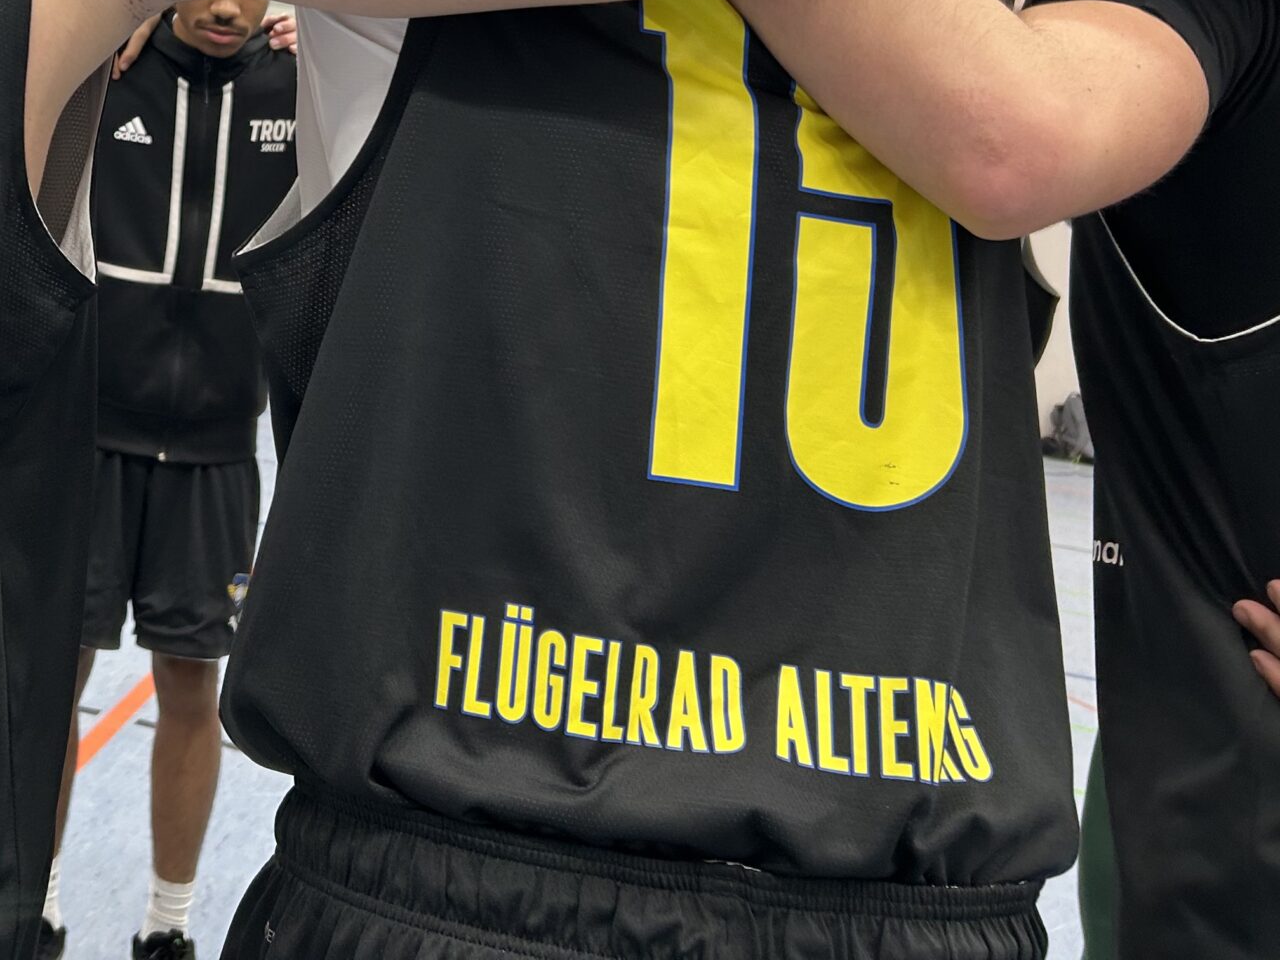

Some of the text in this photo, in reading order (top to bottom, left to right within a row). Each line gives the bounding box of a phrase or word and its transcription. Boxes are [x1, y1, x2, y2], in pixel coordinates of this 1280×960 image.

[113, 130, 153, 144] adidas
[249, 119, 297, 142] TROY
[260, 142, 285, 152] SOCCER
[433, 602, 747, 754] FLÜGELRAD
